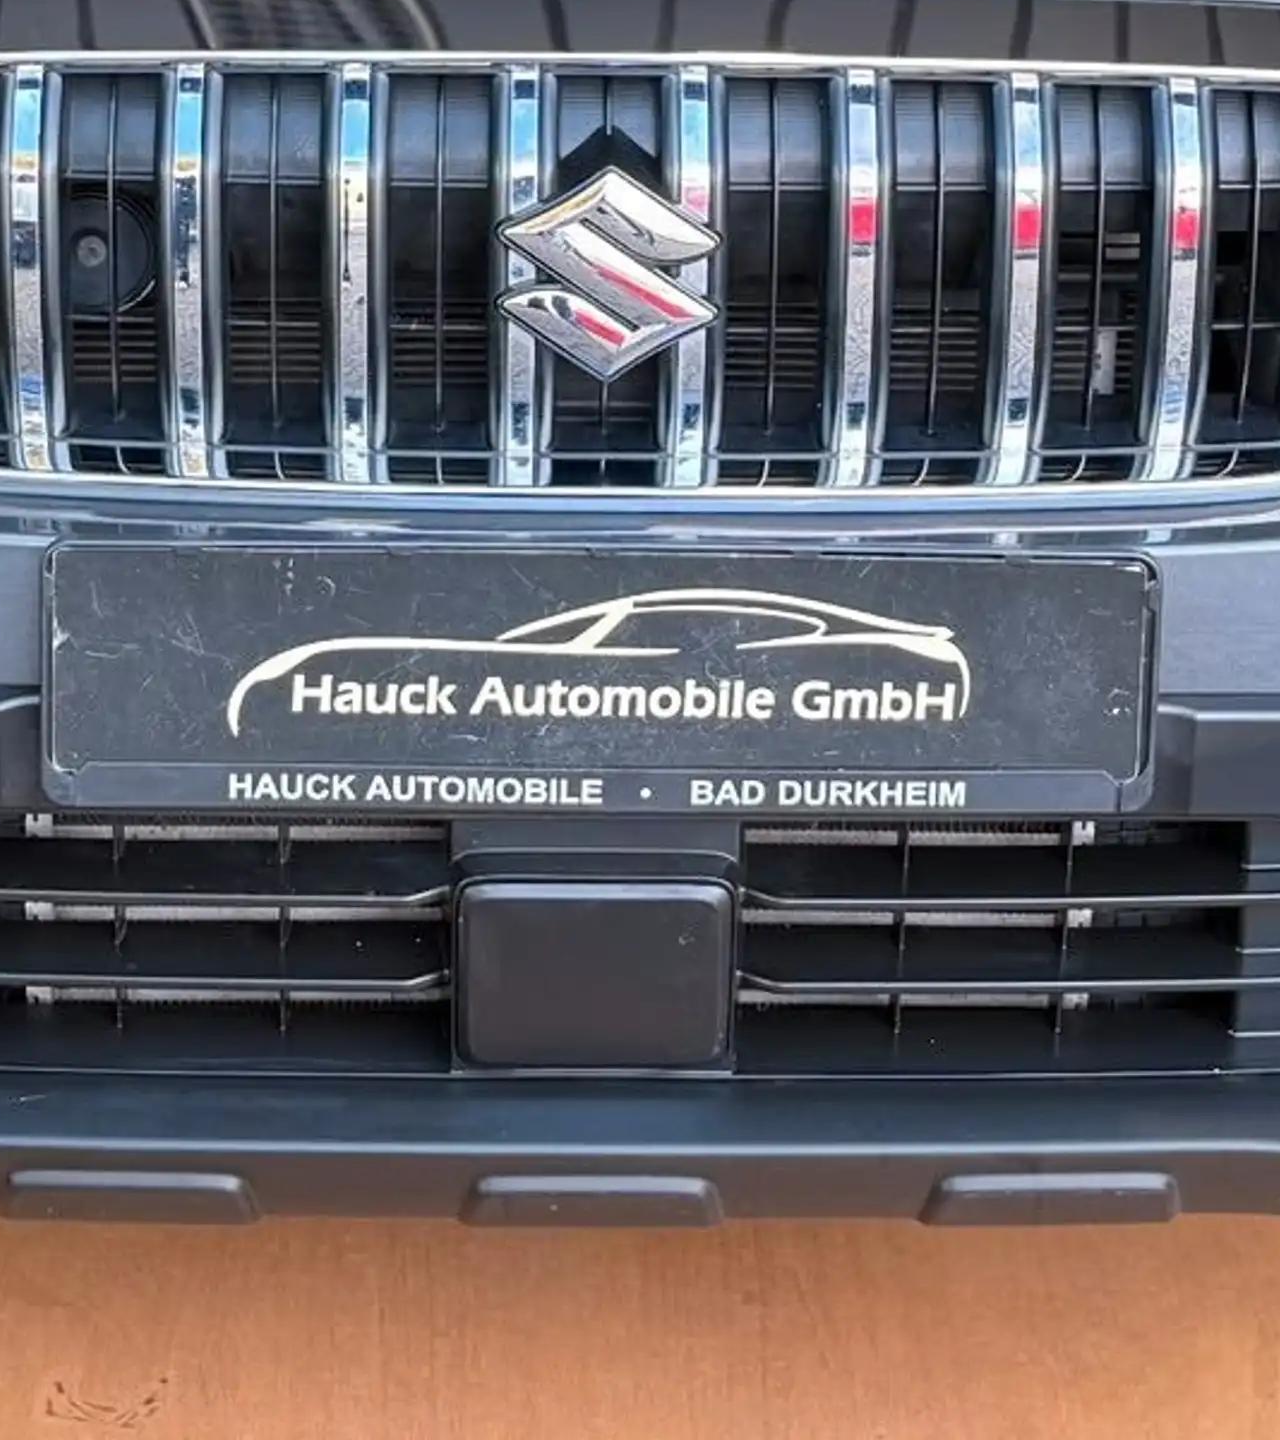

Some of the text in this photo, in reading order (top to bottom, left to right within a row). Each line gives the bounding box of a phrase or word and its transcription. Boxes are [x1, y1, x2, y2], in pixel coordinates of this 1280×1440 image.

[291, 674, 957, 723] Hauck Automobile GmbH
[228, 773, 967, 808] HAUCK AUTOMOBILE BAD DURKHEIM
